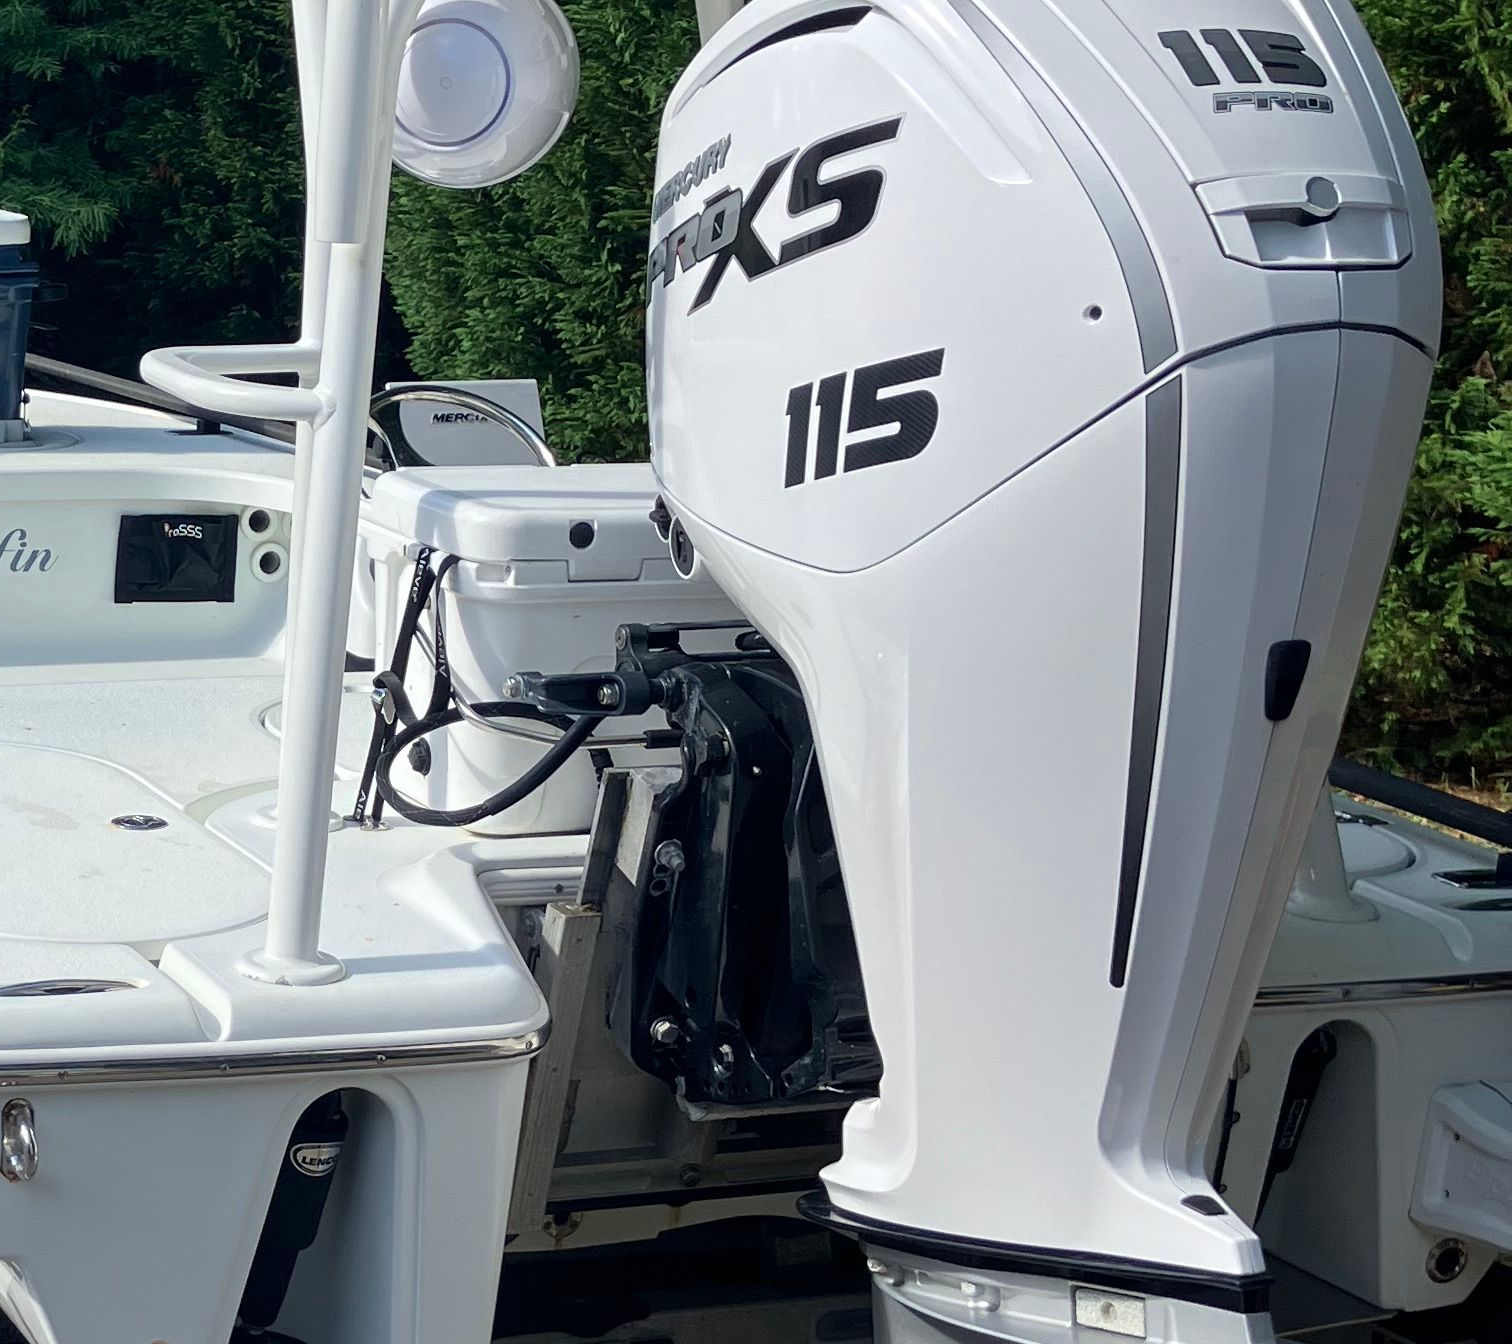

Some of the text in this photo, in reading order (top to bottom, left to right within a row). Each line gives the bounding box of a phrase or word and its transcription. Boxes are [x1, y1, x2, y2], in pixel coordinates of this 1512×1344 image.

[1157, 29, 1327, 87] 115
[1212, 91, 1334, 113] PRO
[652, 133, 731, 223] MERCURY
[784, 347, 945, 489] 115
